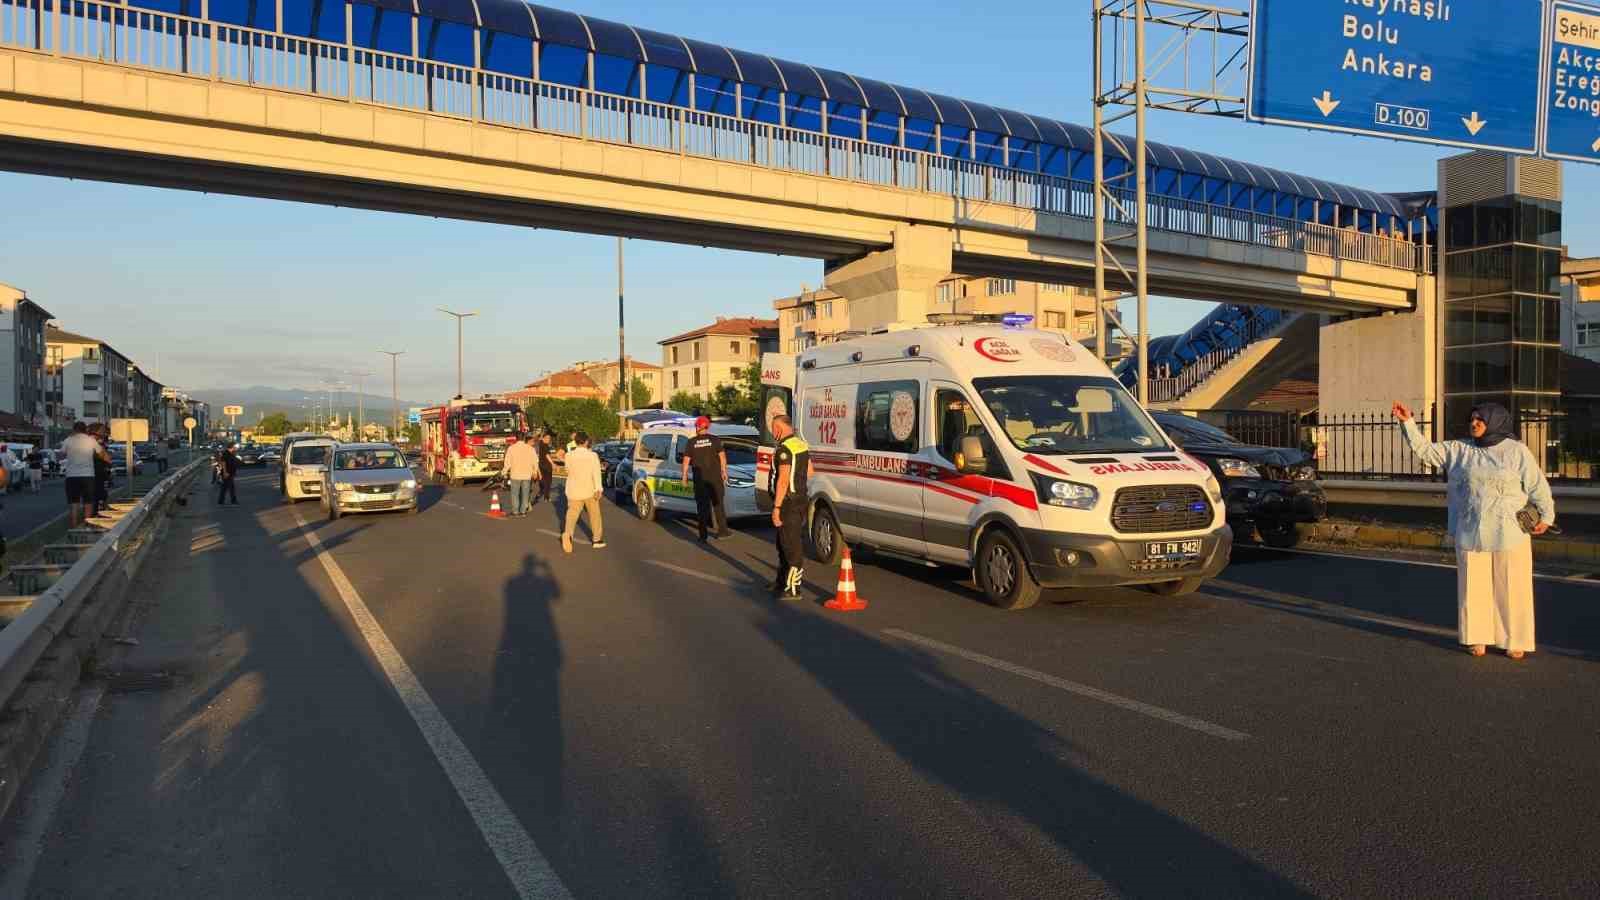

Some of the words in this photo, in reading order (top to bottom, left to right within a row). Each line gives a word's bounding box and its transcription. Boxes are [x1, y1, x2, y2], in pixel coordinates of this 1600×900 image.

[1343, 14, 1398, 44] Bolu
[1559, 17, 1599, 40] Şehir
[1342, 48, 1432, 82] Ankara
[1554, 89, 1600, 117] Zong
[818, 420, 837, 445] 112
[855, 453, 908, 474] AMBULANS
[1150, 544, 1161, 555] 81
[1182, 541, 1197, 553] 942
